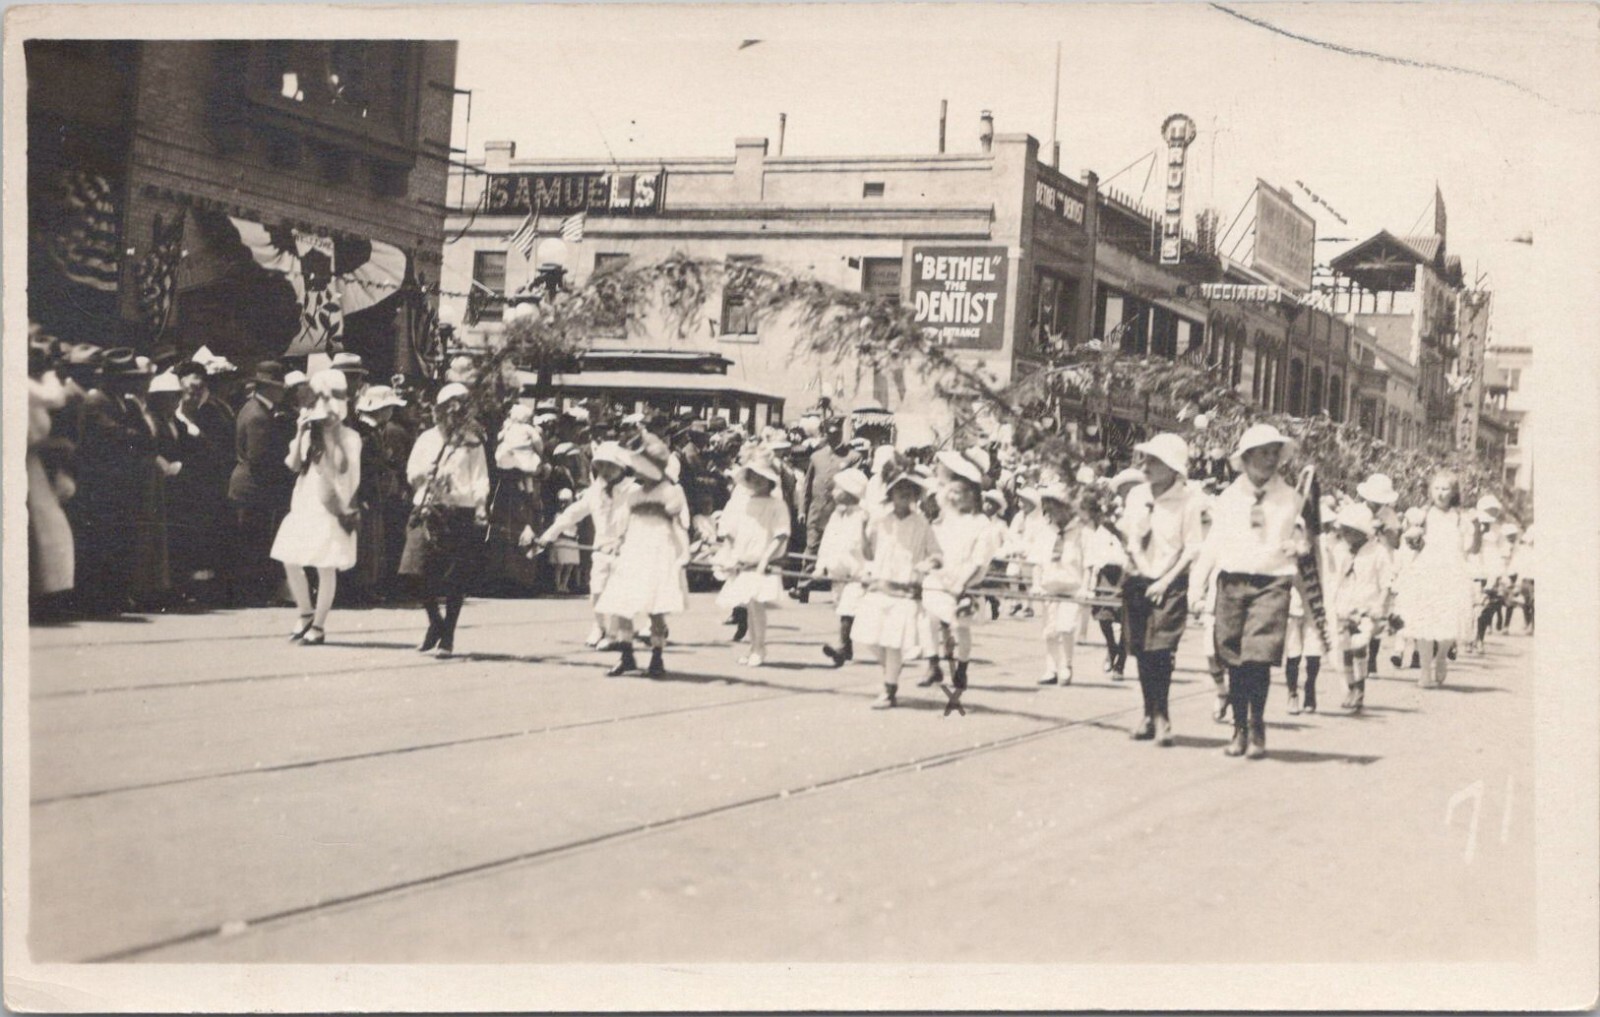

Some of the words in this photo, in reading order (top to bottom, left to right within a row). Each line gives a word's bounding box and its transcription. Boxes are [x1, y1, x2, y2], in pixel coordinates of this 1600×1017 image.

[491, 174, 657, 208] SAMUELS
[915, 252, 1002, 281] "BETHEL"
[944, 281, 967, 292] THE
[914, 291, 998, 324] DENTIST
